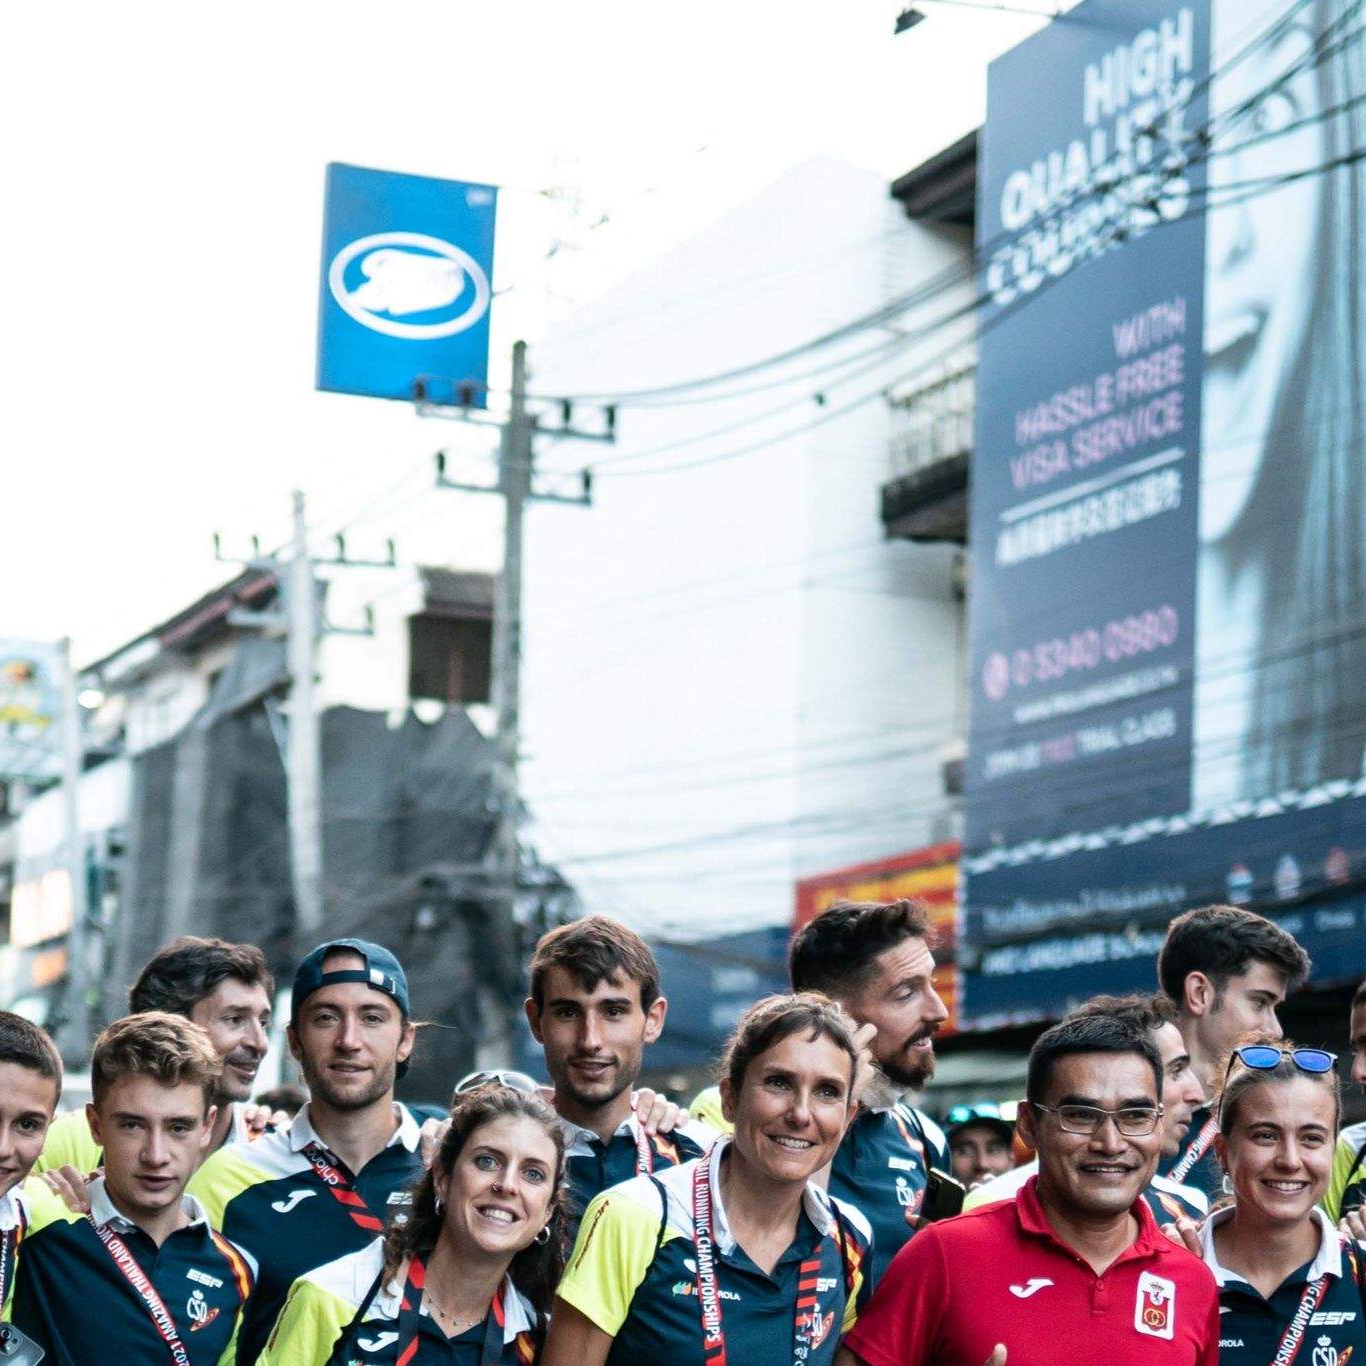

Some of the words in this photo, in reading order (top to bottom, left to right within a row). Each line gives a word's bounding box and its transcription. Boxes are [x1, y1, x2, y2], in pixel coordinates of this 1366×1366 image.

[1085, 8, 1193, 127] HIGH
[1114, 297, 1185, 358] WITH
[1015, 373, 1115, 445] HASSLE
[1116, 344, 1184, 403] FREE
[1009, 440, 1071, 489] VISA
[1072, 391, 1184, 468] SERVICE
[694, 1184, 712, 1236] RUNNING
[107, 1241, 151, 1296] THAILAND
[186, 1268, 223, 1289] ESP
[697, 1237, 722, 1343] CHAMPIONSHIPS
[142, 1292, 178, 1341] AMAZING
[1309, 1311, 1356, 1326] ESP
